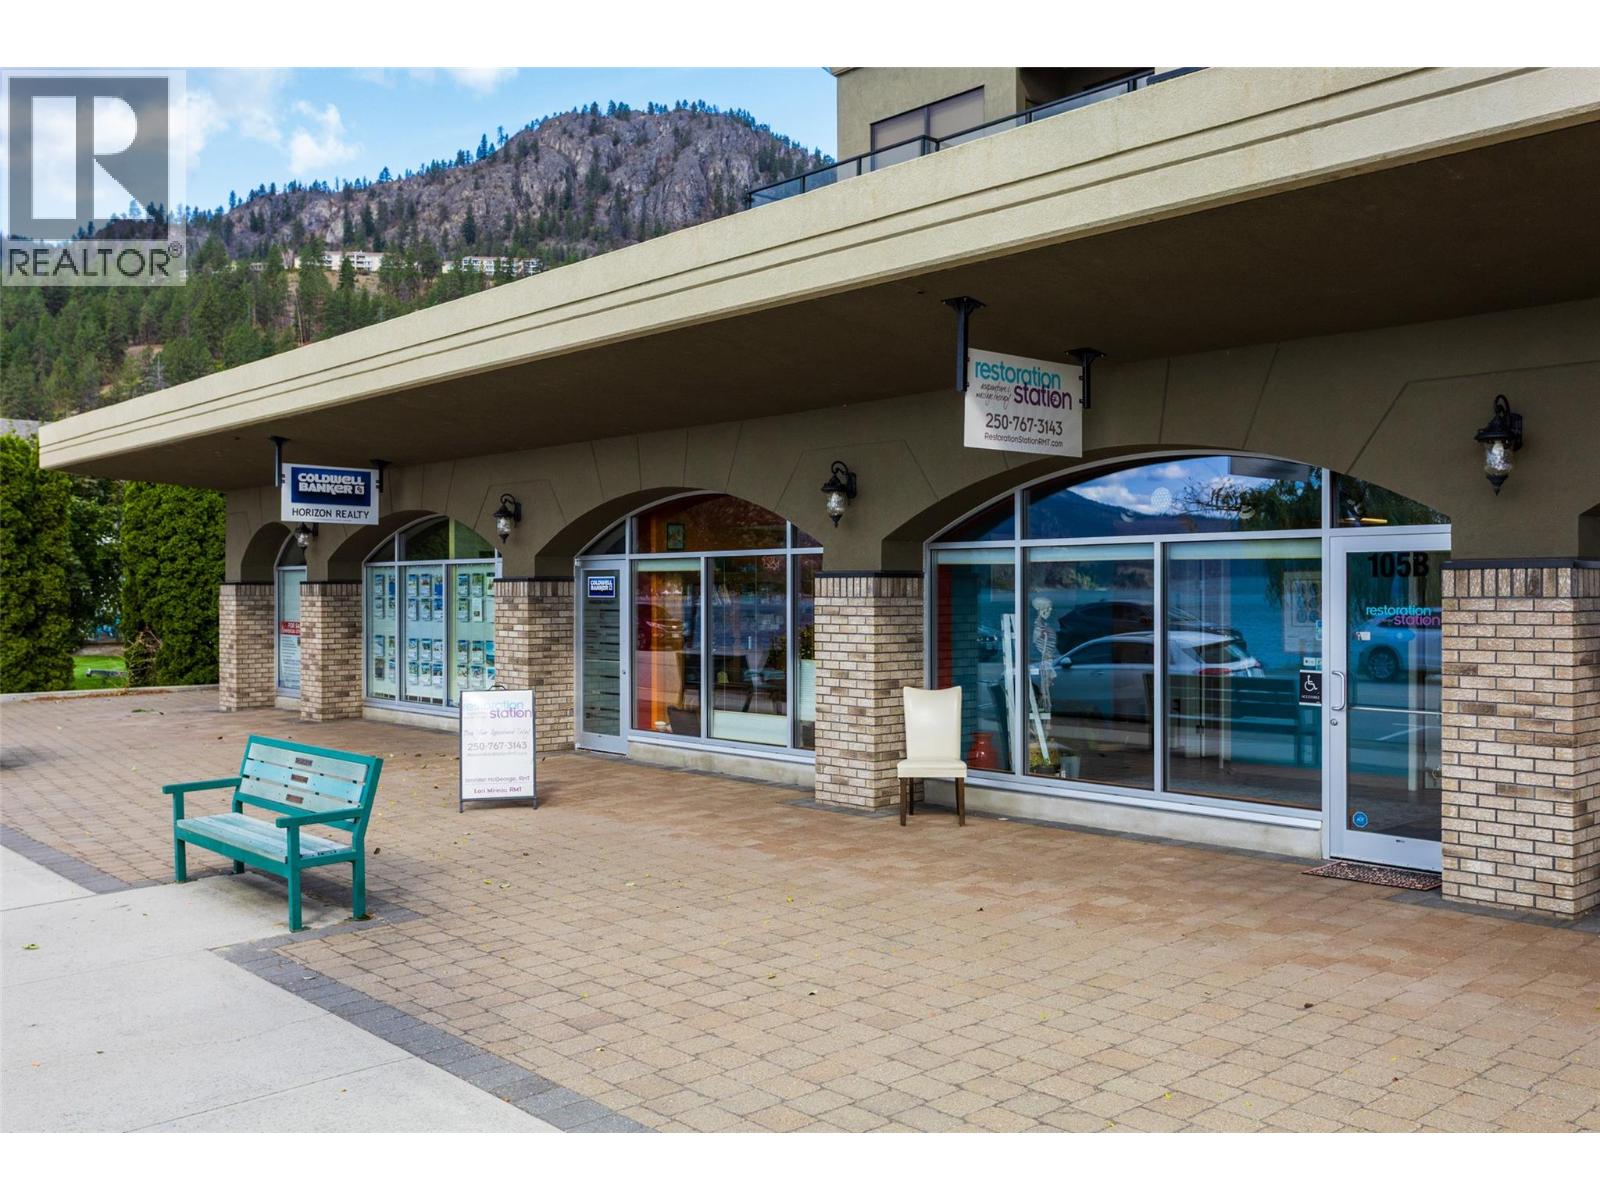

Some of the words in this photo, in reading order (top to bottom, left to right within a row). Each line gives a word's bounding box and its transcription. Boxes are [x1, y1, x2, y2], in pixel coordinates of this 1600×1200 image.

[974, 360, 1061, 390] restoration
[1013, 381, 1072, 411] station
[985, 412, 1063, 436] 250-767-3143
[984, 432, 1063, 448] RestorationStationRMT.com
[298, 472, 365, 485] COLDWELL
[298, 482, 353, 496] BANKER
[292, 507, 332, 518] HORIZON
[335, 509, 370, 520] REALTY
[1367, 552, 1429, 578] 105B
[1366, 604, 1432, 616] restoration
[1393, 615, 1441, 626] station
[489, 707, 533, 719] station
[467, 741, 528, 752] 250-767-3143
